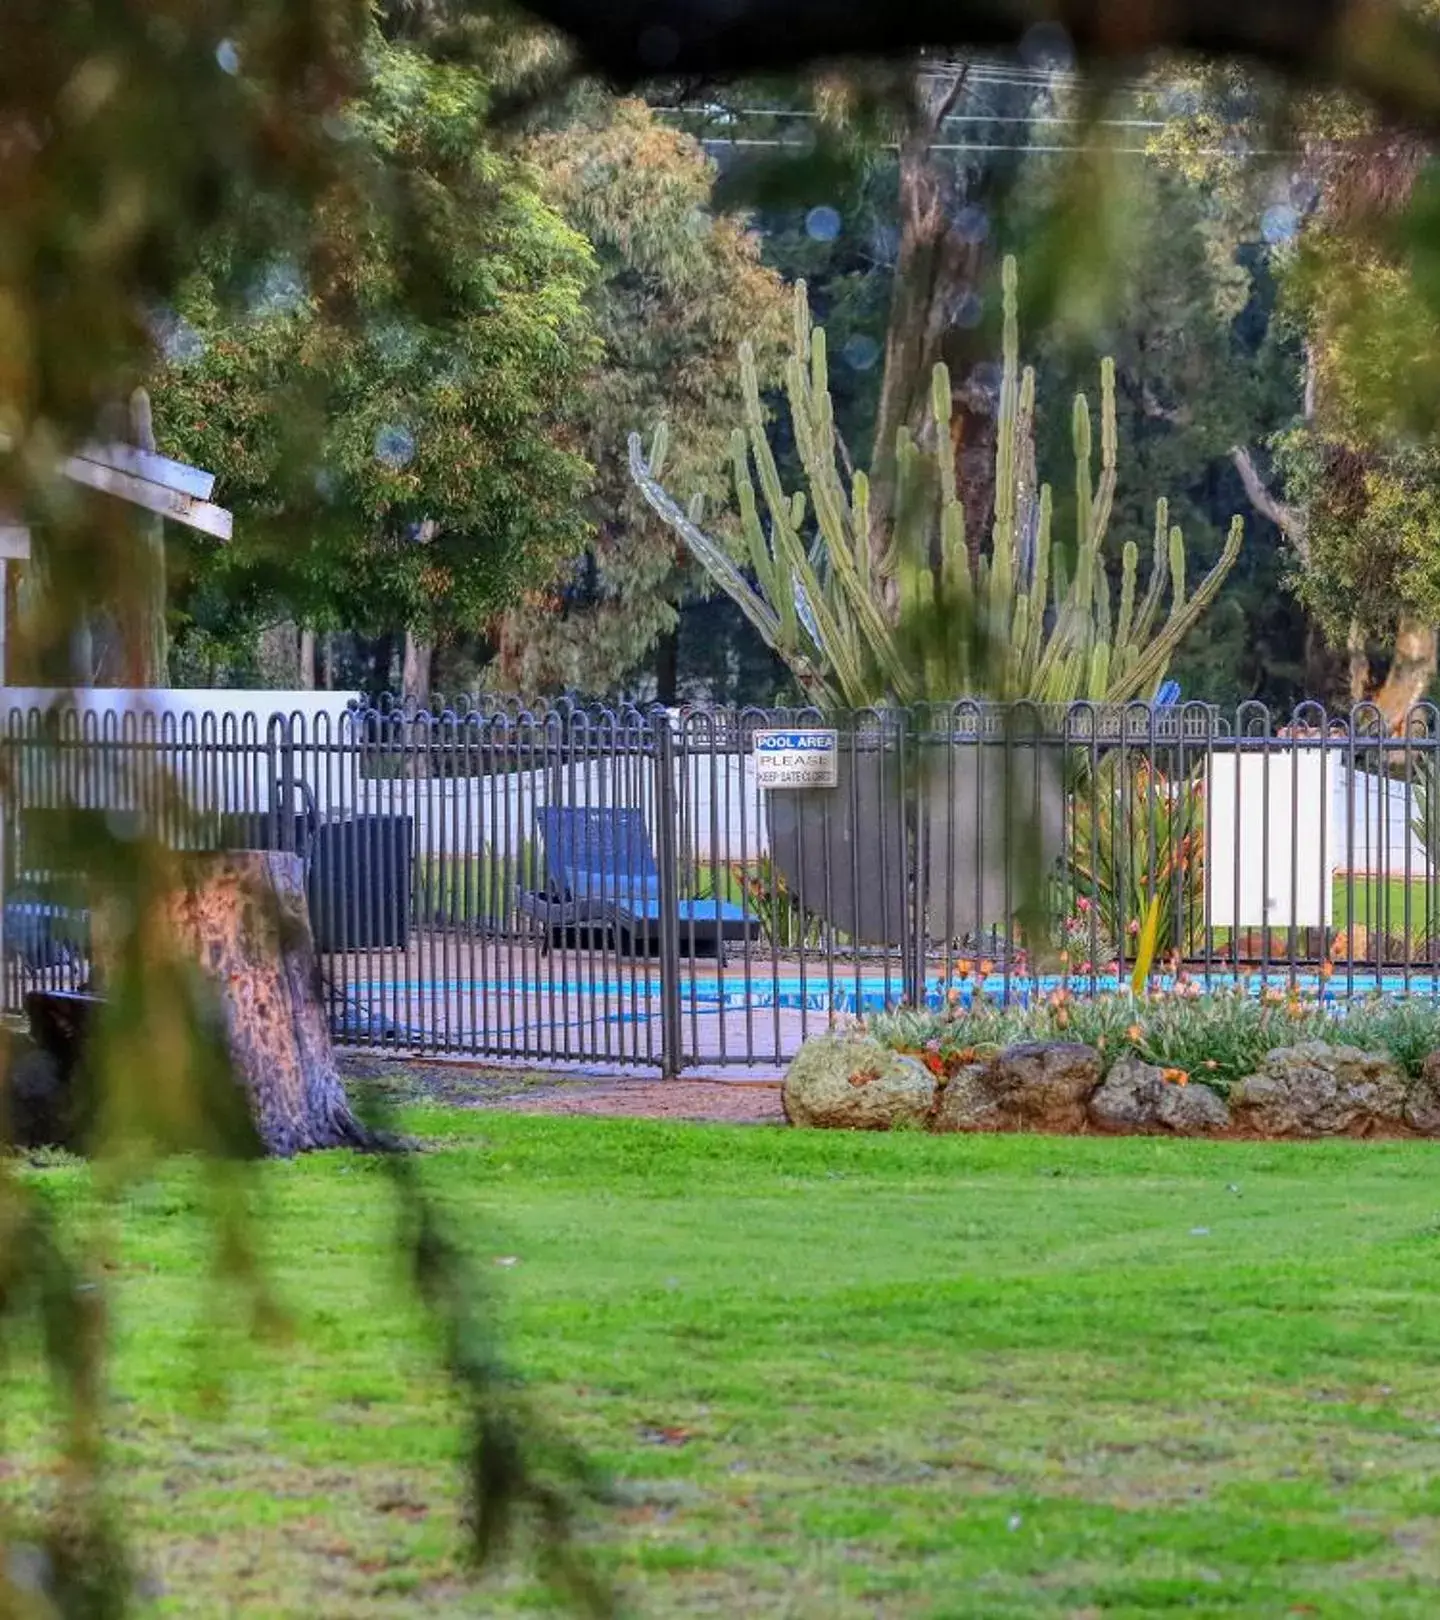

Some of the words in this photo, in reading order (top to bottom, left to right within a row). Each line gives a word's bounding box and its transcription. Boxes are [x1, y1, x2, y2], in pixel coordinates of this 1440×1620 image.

[758, 737, 795, 747] POOL
[798, 737, 833, 747] AREA
[760, 756, 830, 766] PLEASE
